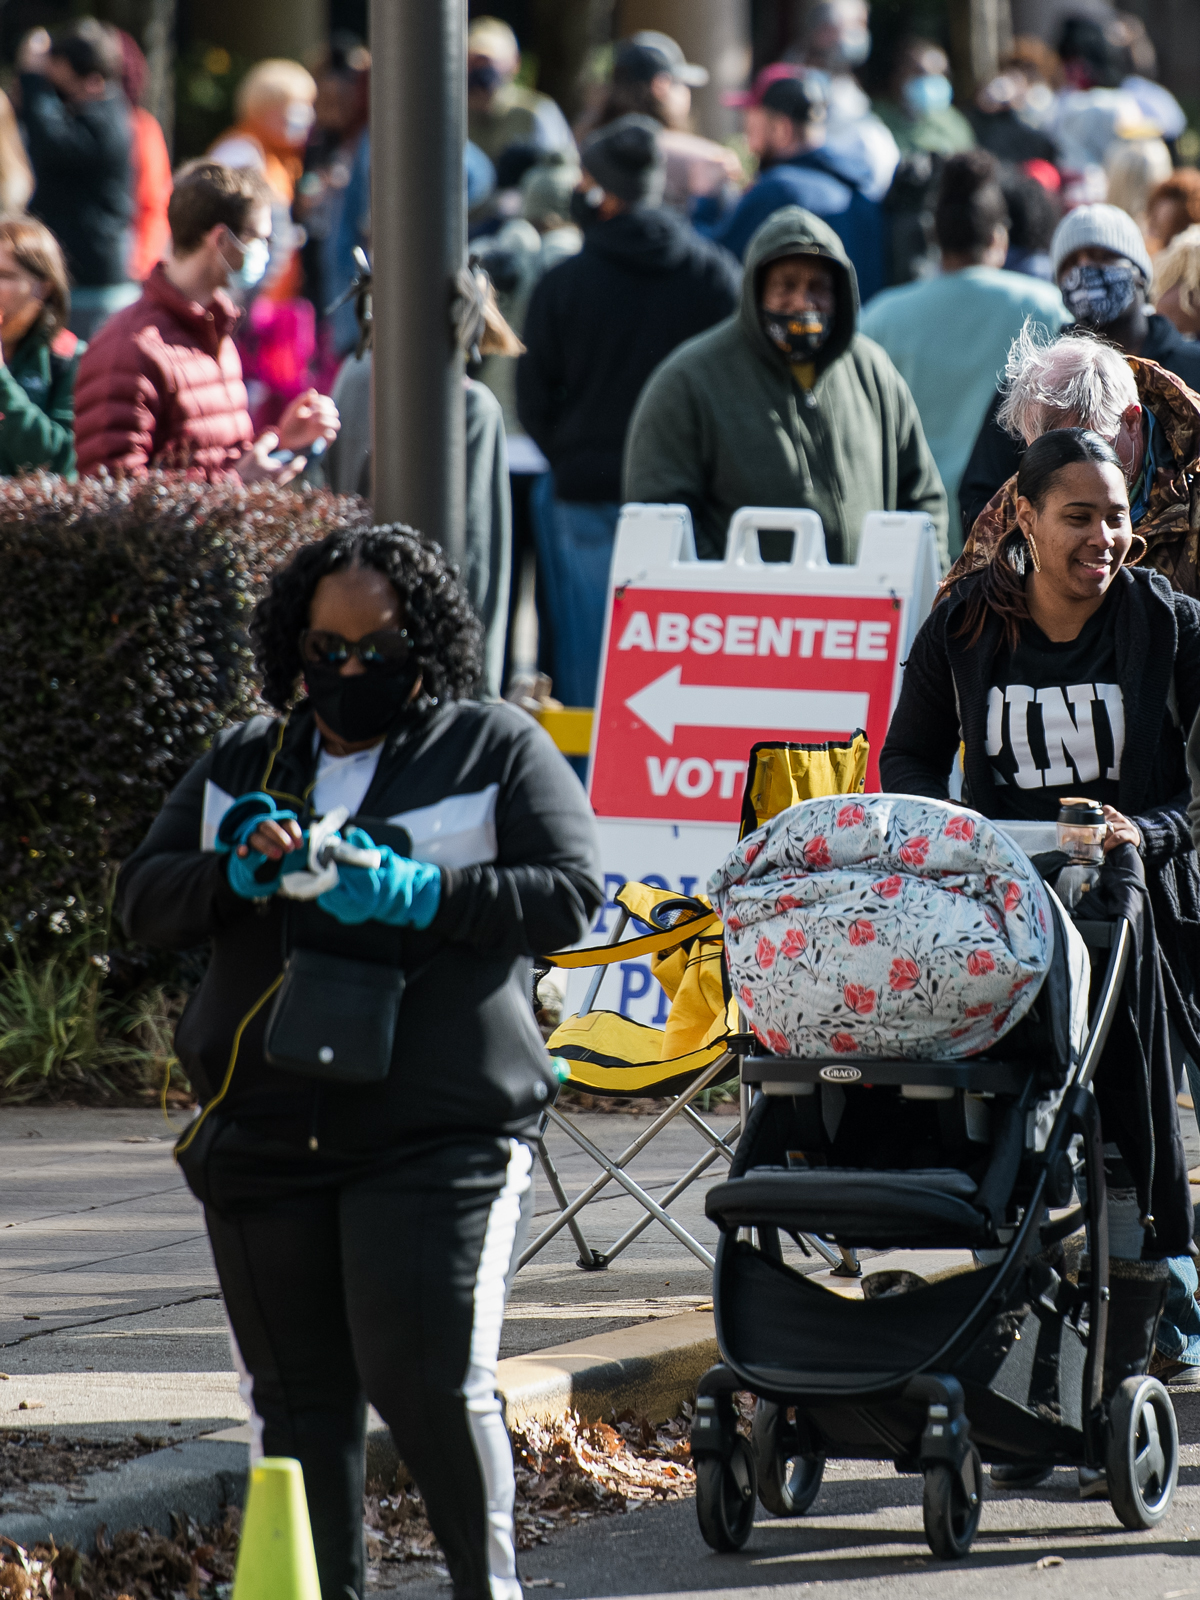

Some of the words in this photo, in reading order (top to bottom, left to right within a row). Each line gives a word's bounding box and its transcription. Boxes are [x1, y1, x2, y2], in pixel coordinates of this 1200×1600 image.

[617, 611, 891, 661] ABSENTEE
[646, 756, 749, 798] VOT
[826, 1069, 858, 1078] GRACO
